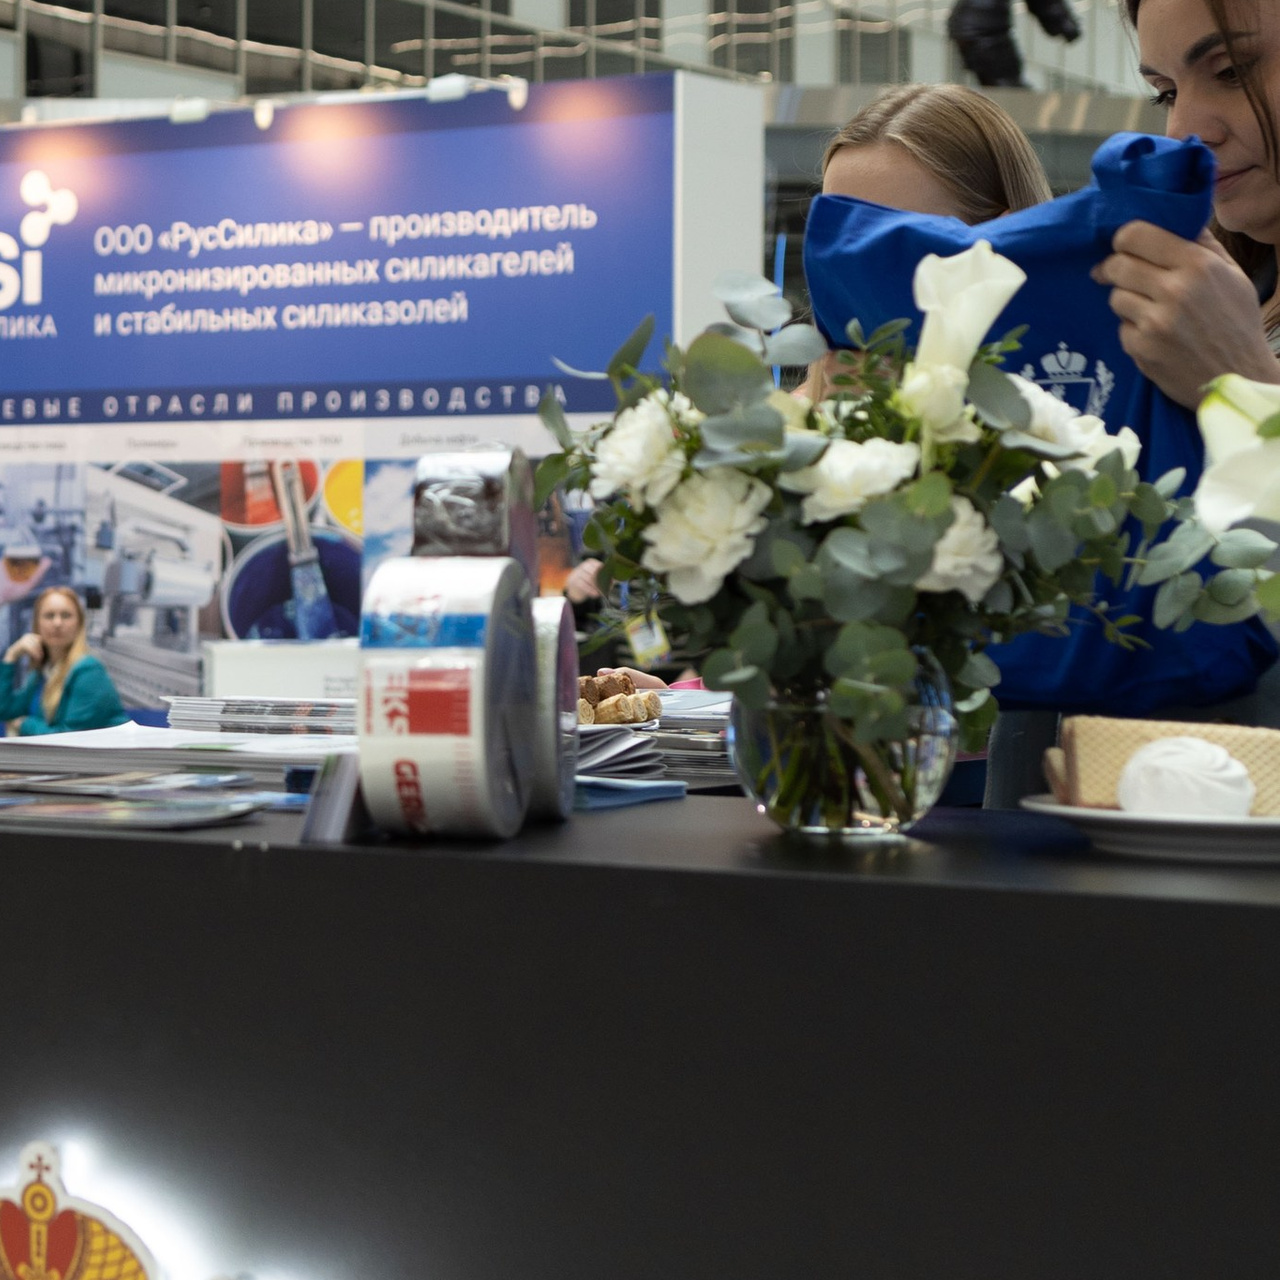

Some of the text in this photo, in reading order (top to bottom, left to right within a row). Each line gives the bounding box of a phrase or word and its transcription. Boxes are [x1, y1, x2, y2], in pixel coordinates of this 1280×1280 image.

[93, 223, 154, 257] ООО
[157, 218, 334, 258] «РусСилика»
[369, 203, 598, 248] производитель
[93, 241, 575, 301] микронизированных силикагелей
[93, 290, 469, 337] и стабильных силиказолей
[103, 392, 254, 418] ОТРАСЛИ
[276, 384, 568, 414] ПРОИЗВОДСТВА
